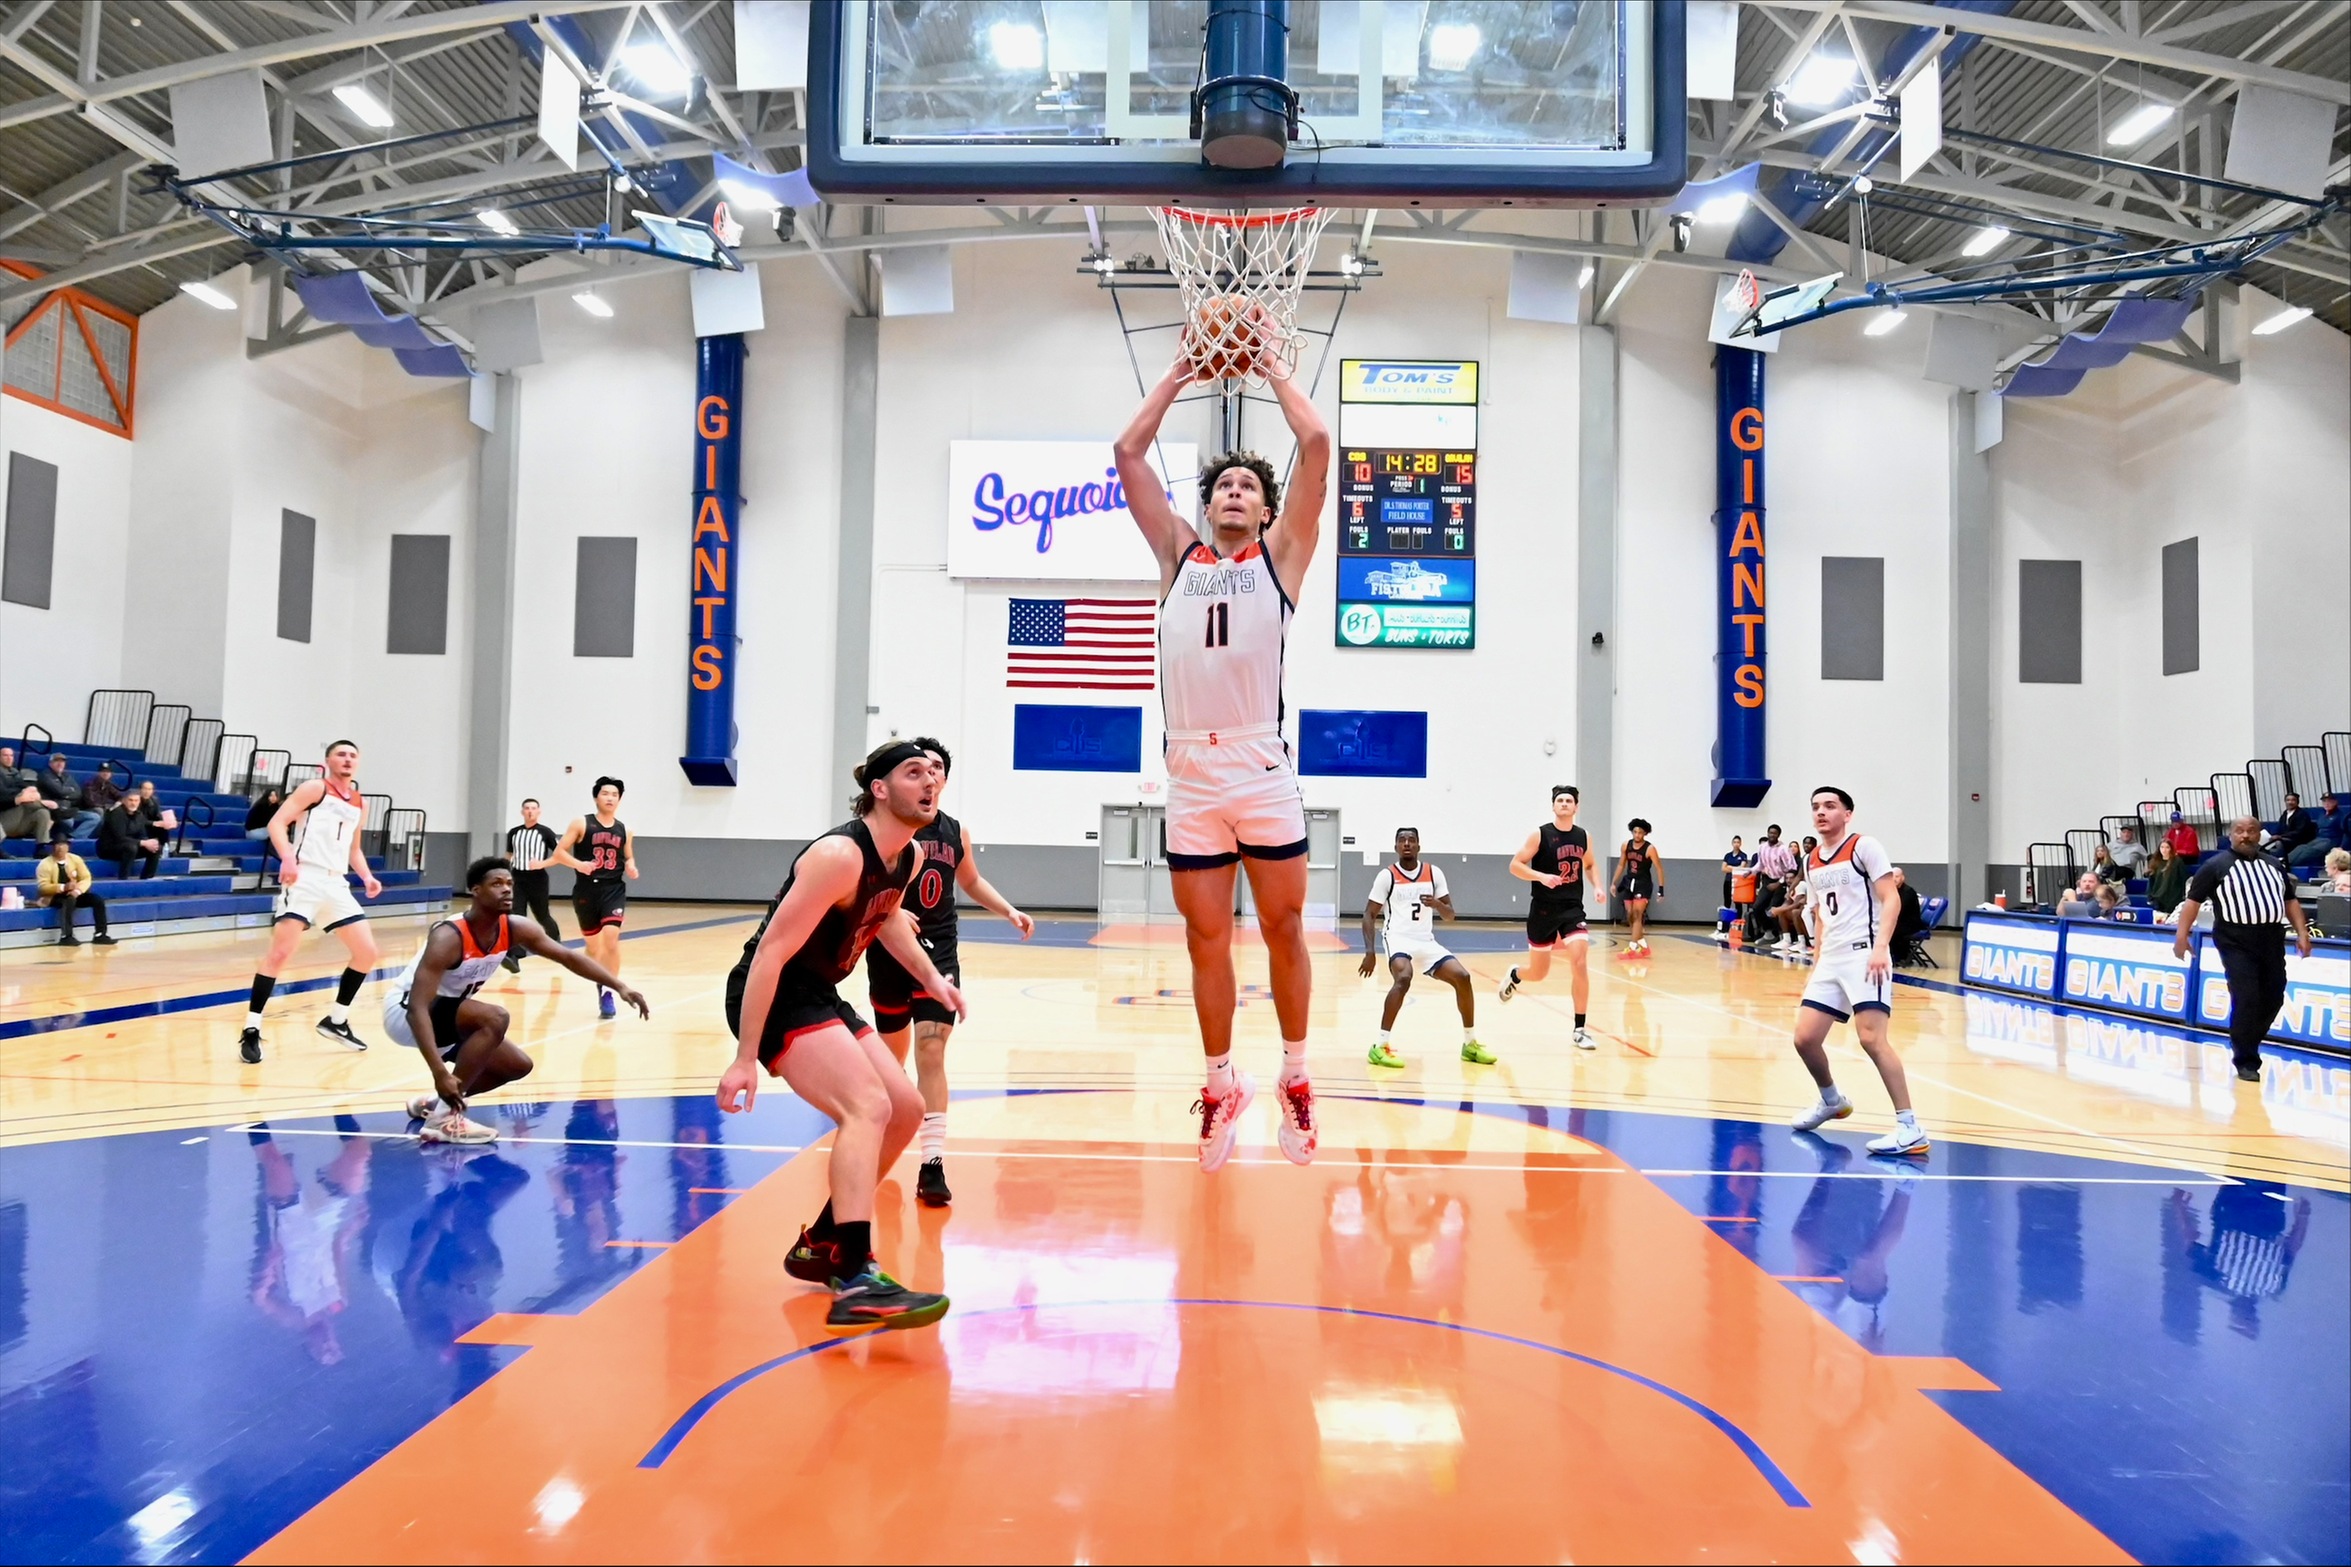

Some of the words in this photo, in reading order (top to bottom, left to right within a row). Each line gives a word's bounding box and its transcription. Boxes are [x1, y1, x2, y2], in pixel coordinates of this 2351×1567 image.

[1359, 364, 1461, 384] TOM'S
[1355, 463, 1372, 483] 10
[1386, 454, 1437, 472] 14:28
[1456, 465, 1473, 485] 15
[1352, 502, 1363, 517] 6
[1388, 511, 1406, 520] FIELD
[1406, 512, 1426, 520] HOUSE
[692, 395, 730, 691] GIANTS
[1358, 533, 1369, 548] 2
[1729, 406, 1765, 708] GIANTS
[1184, 569, 1256, 597] GIANTS
[1205, 602, 1229, 648] 11
[1428, 630, 1470, 645] TORTS
[337, 822, 343, 840] 1
[593, 847, 617, 870] 33
[919, 869, 943, 908] 0
[1412, 903, 1421, 920] 2
[1826, 892, 1838, 916] 0
[1966, 946, 2055, 990] GIANTS
[2067, 958, 2186, 1012] GIANTS
[2202, 977, 2351, 1042] GNTS
